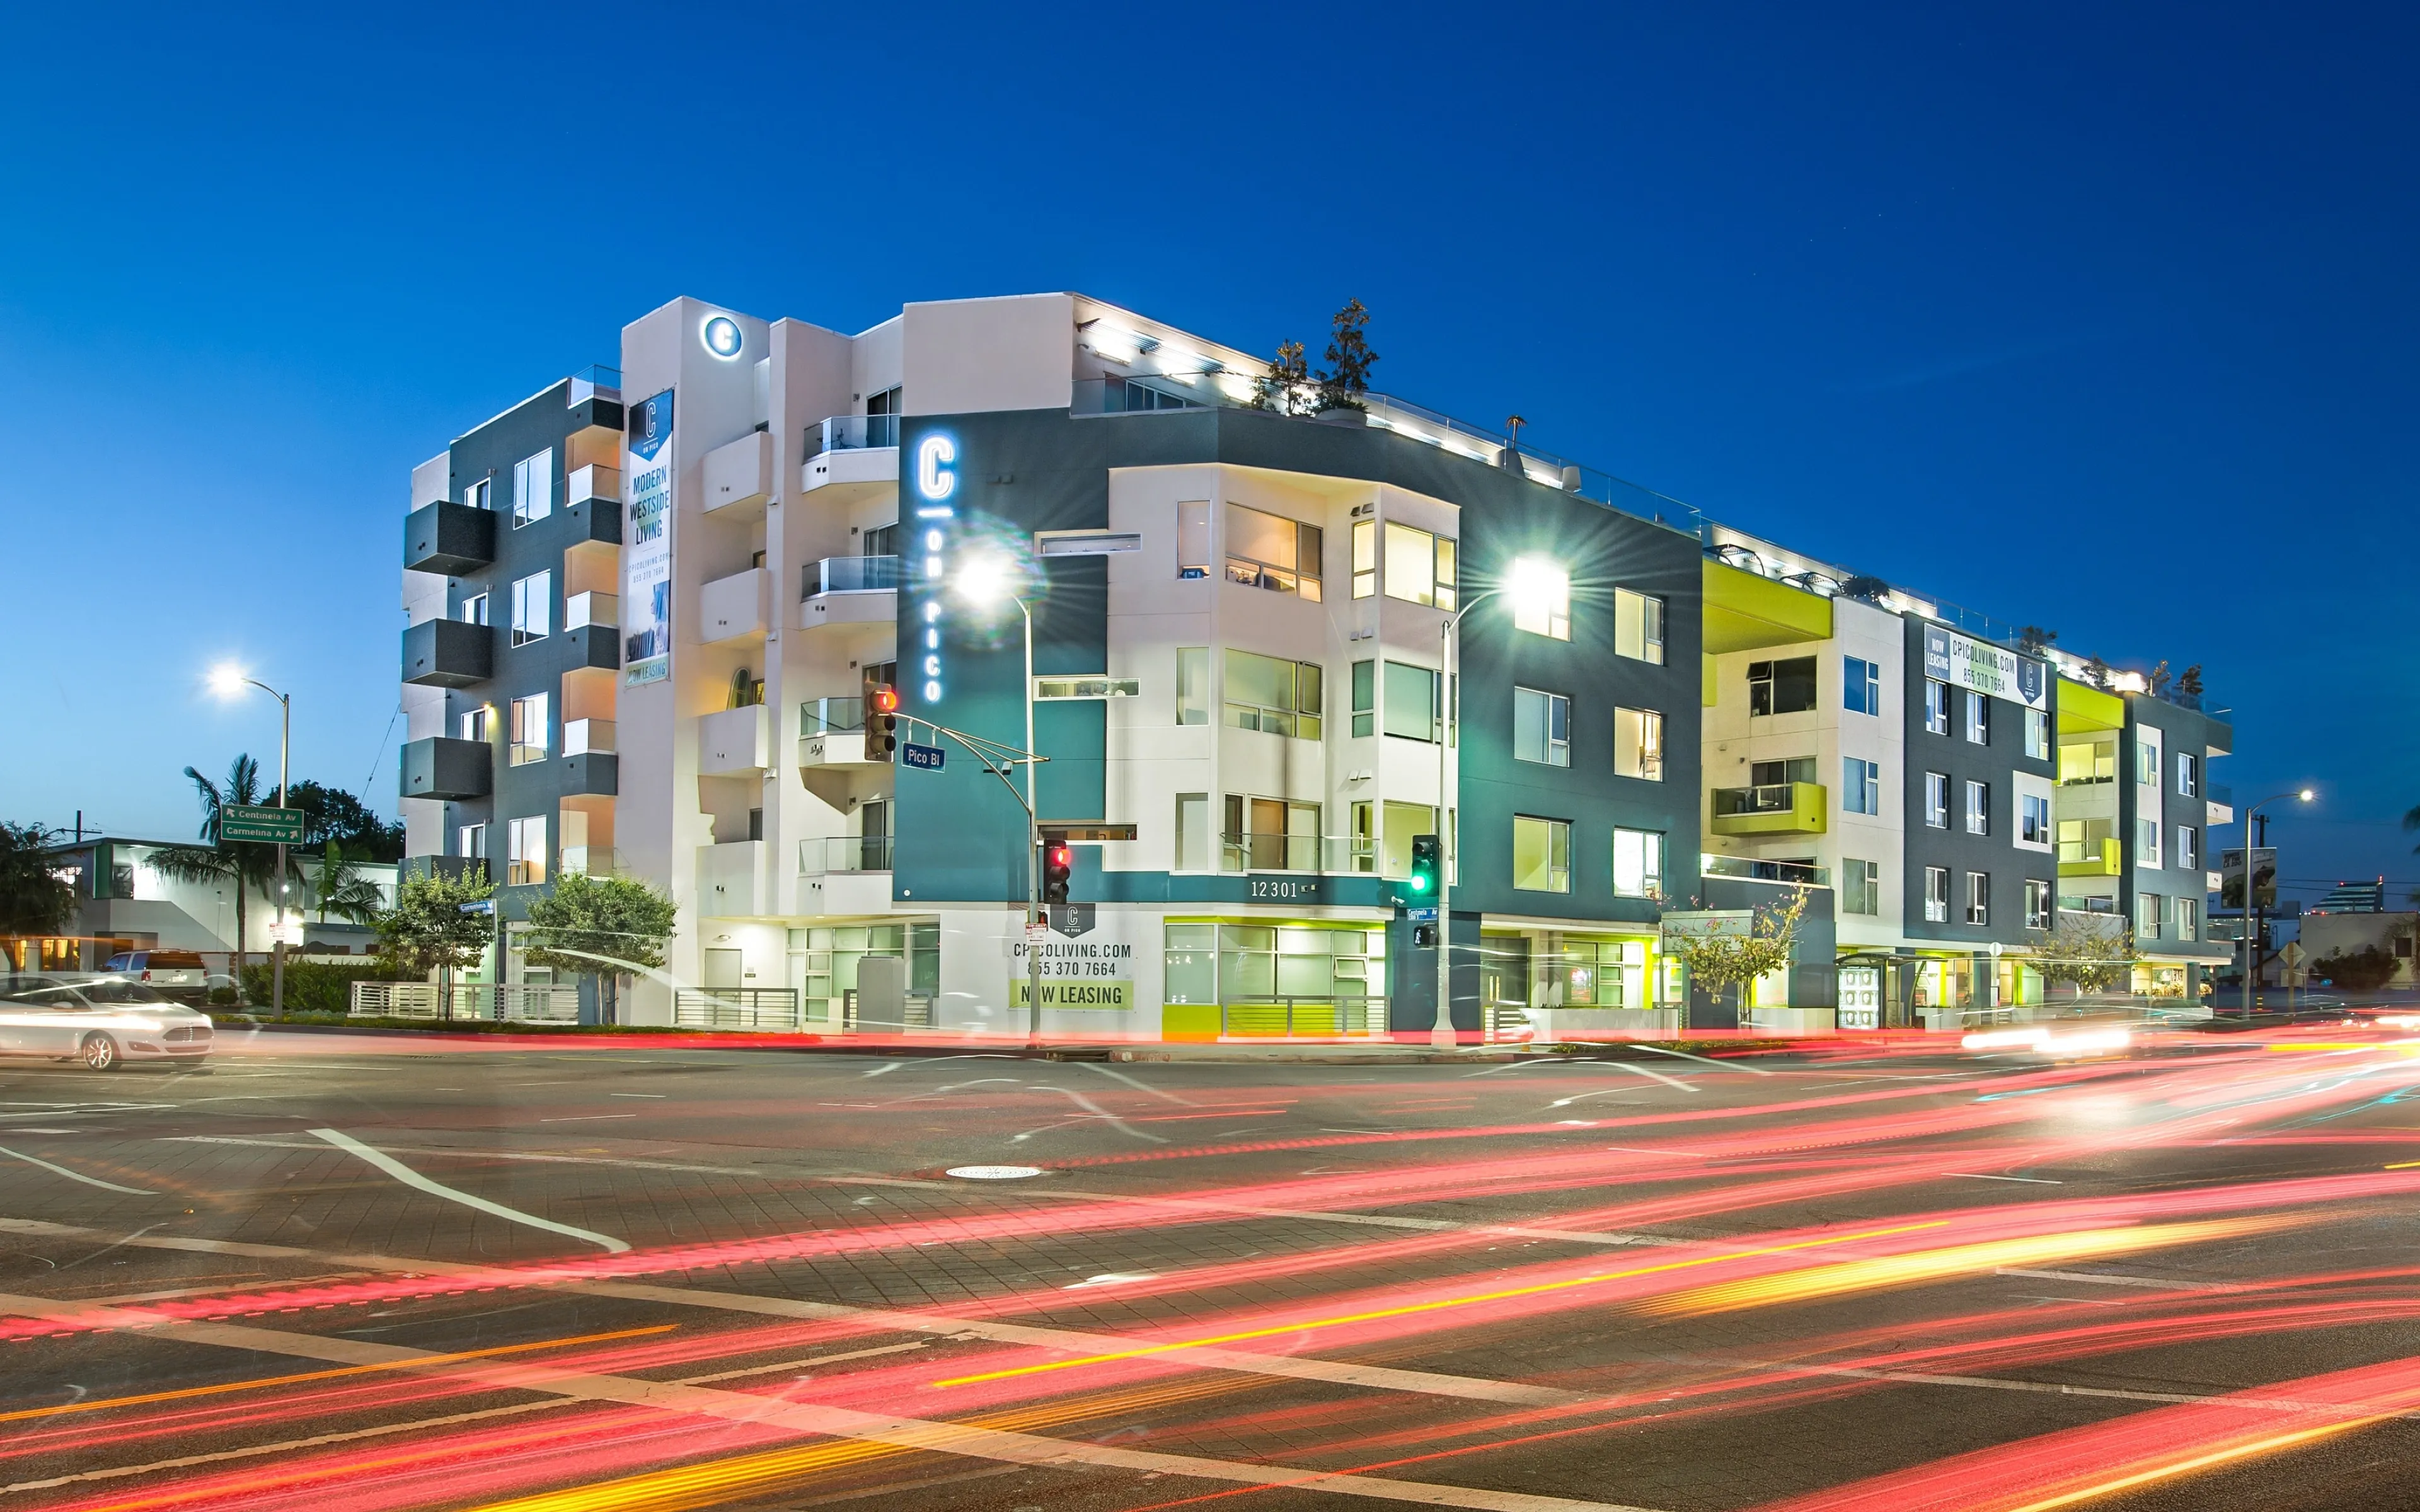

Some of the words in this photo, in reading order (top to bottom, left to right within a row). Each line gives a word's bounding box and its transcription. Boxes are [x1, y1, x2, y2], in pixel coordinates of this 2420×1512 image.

[713, 323, 732, 350] C
[646, 402, 656, 438] C
[919, 436, 953, 498] C
[633, 464, 667, 495] MODERN
[630, 490, 670, 522] WESTSIDE
[636, 519, 662, 545] LIVING
[927, 602, 941, 703] PICO
[1932, 638, 1944, 654] NOW
[1927, 651, 1949, 670] LEASING
[1952, 640, 2015, 675] CPICOLIVING.COM
[642, 662, 666, 679] LEASING
[1963, 668, 1975, 684] 855
[1977, 672, 1988, 688] 370
[1990, 676, 2005, 693] 7664
[2025, 663, 2033, 687] C
[908, 748, 928, 764] Pico
[931, 753, 940, 766] Bl
[239, 810, 281, 821] Centinela
[227, 827, 272, 837] Carmelina
[1067, 906, 1078, 925] C
[1014, 943, 1131, 958] CPCOLIVING.COM
[1056, 962, 1079, 975] 370
[1085, 963, 1116, 976] 7664
[1021, 986, 1055, 1002] NW
[1060, 987, 1122, 1004] LEASING
